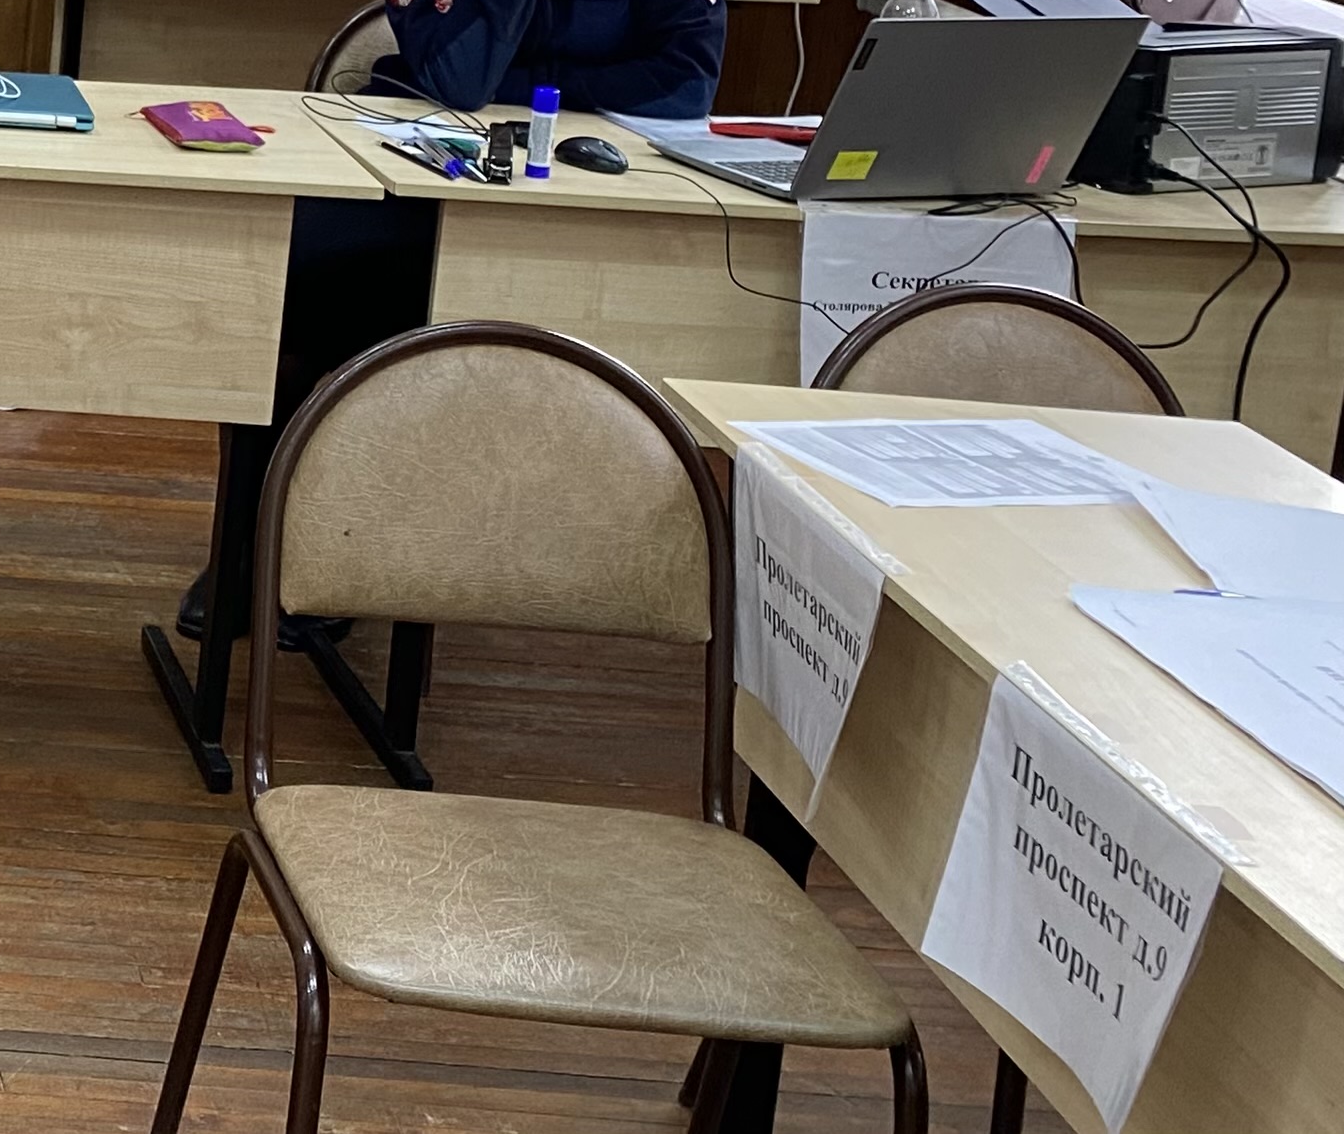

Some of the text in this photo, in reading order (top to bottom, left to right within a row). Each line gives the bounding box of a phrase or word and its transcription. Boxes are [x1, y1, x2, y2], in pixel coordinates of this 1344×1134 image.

[813, 300, 884, 314] Столярова
[756, 535, 861, 666] Пролетарский
[764, 599, 849, 708] проспект д.9
[1011, 743, 1192, 933] Пролетарский
[1013, 825, 1168, 982] проспект д.9
[1038, 918, 1125, 1022] корп. 1
